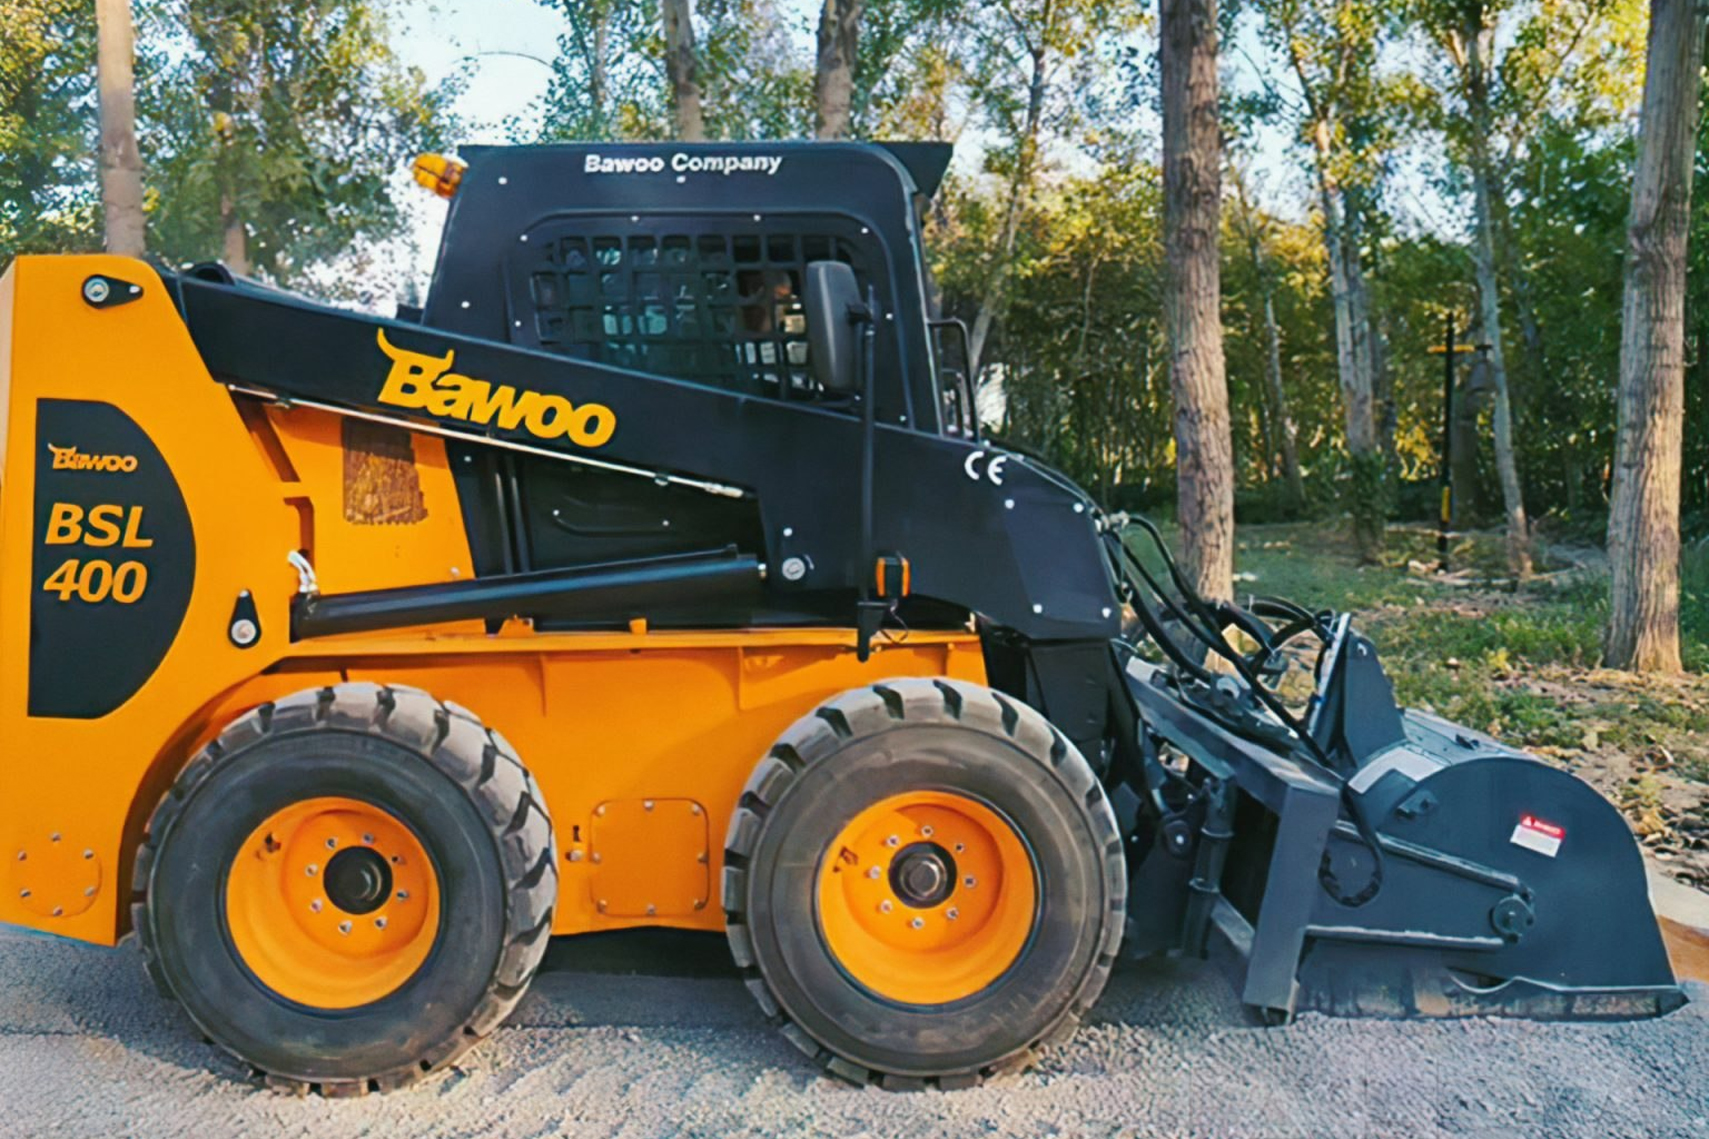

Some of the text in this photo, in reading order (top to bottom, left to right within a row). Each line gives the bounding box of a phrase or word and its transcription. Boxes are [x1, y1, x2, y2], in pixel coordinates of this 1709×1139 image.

[584, 153, 783, 175] Bawoo Company
[377, 327, 617, 447] Bawoo
[964, 451, 1007, 486] CE
[45, 502, 154, 548] BSL
[43, 559, 148, 604] 400
